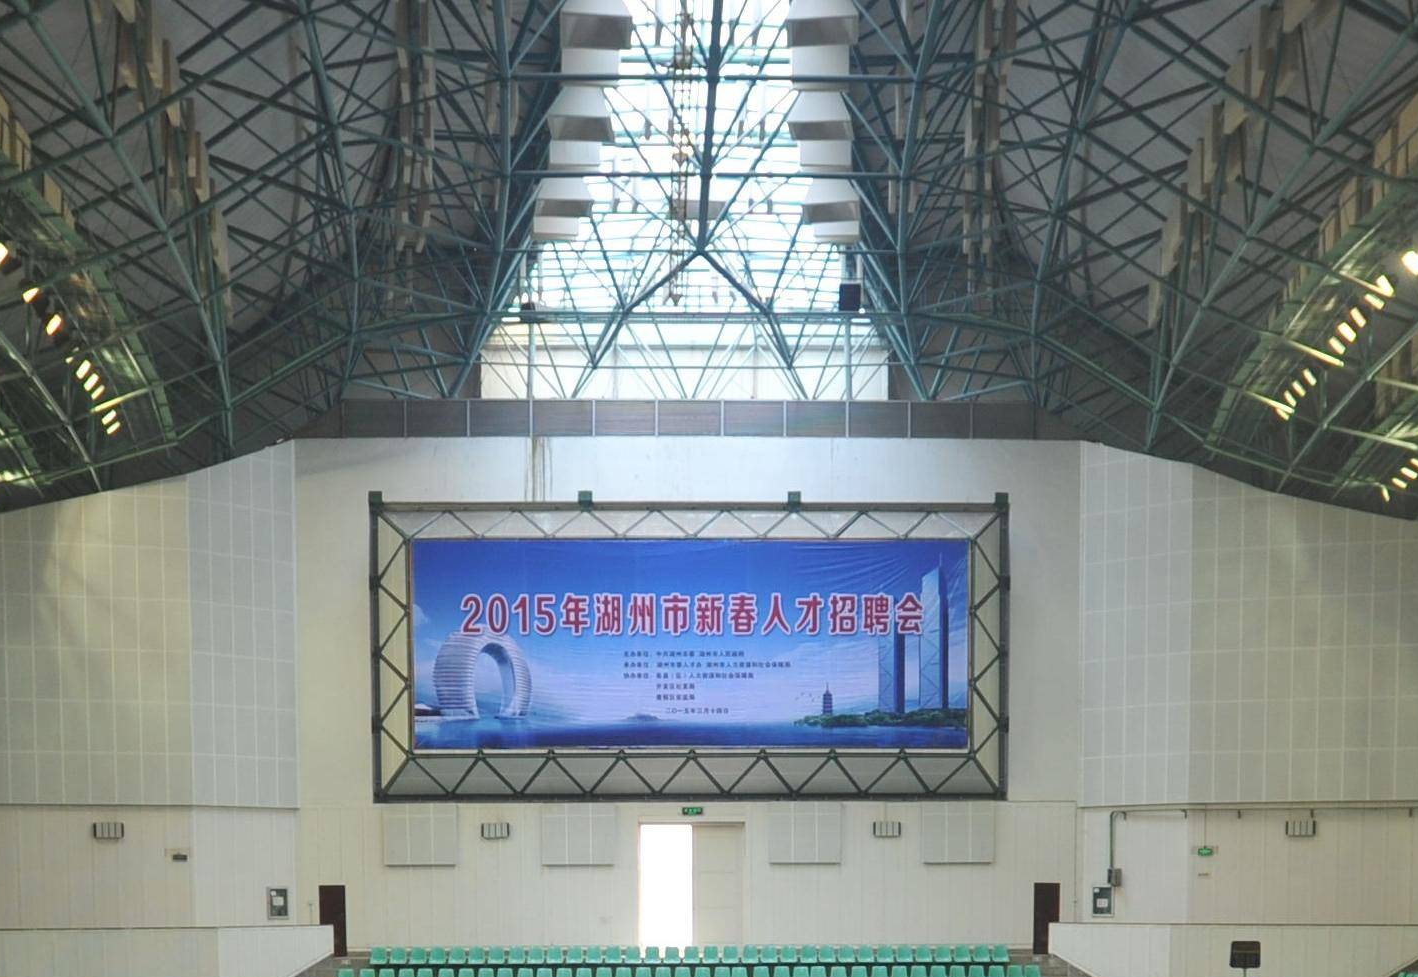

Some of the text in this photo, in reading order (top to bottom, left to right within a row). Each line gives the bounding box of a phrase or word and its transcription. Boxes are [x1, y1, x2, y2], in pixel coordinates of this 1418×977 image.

[461, 593, 923, 636] 2015年湖州市新春人才招聘会
